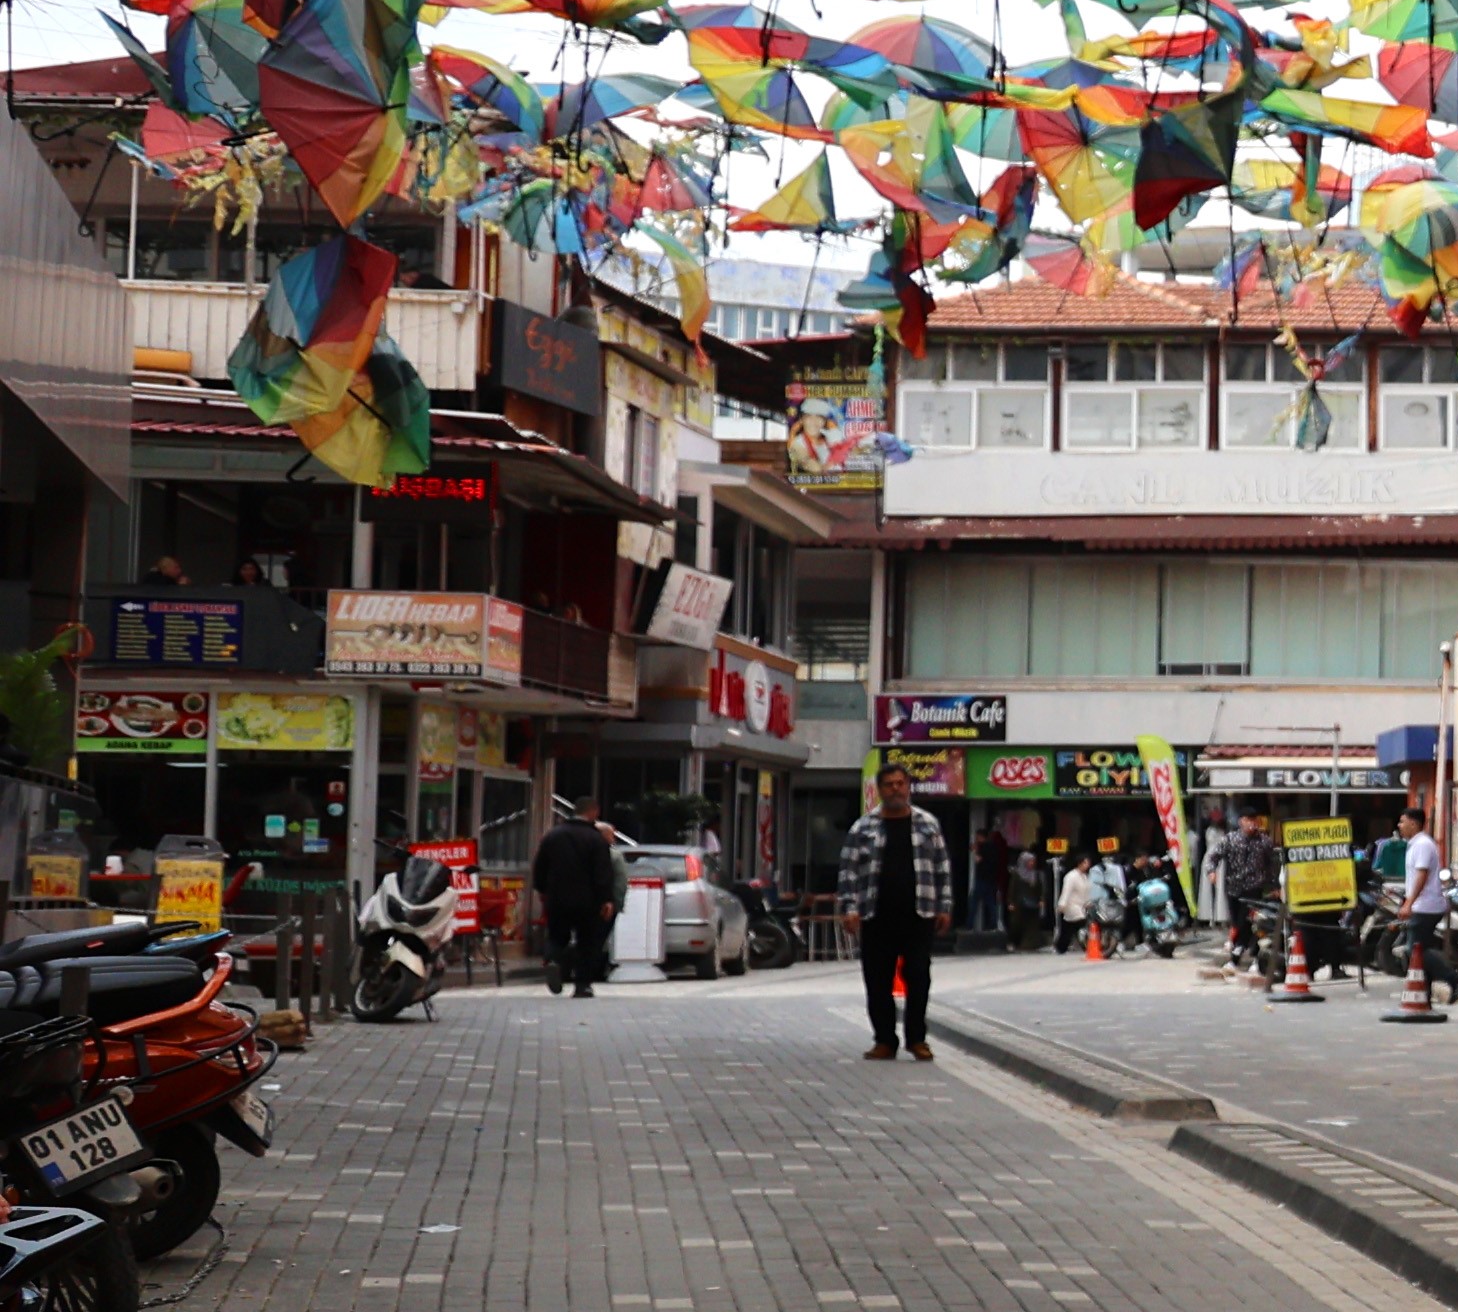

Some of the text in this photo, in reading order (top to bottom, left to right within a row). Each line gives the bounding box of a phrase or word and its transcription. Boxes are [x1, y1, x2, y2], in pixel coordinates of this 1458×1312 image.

[911, 700, 1005, 728] Botanik Cafe
[1056, 750, 1187, 769] FLOWR
[1266, 770, 1389, 786] FLOWER
[1288, 844, 1349, 862] OTO PARK
[28, 1104, 121, 1159] 01 ANU
[70, 1137, 117, 1171] 128
